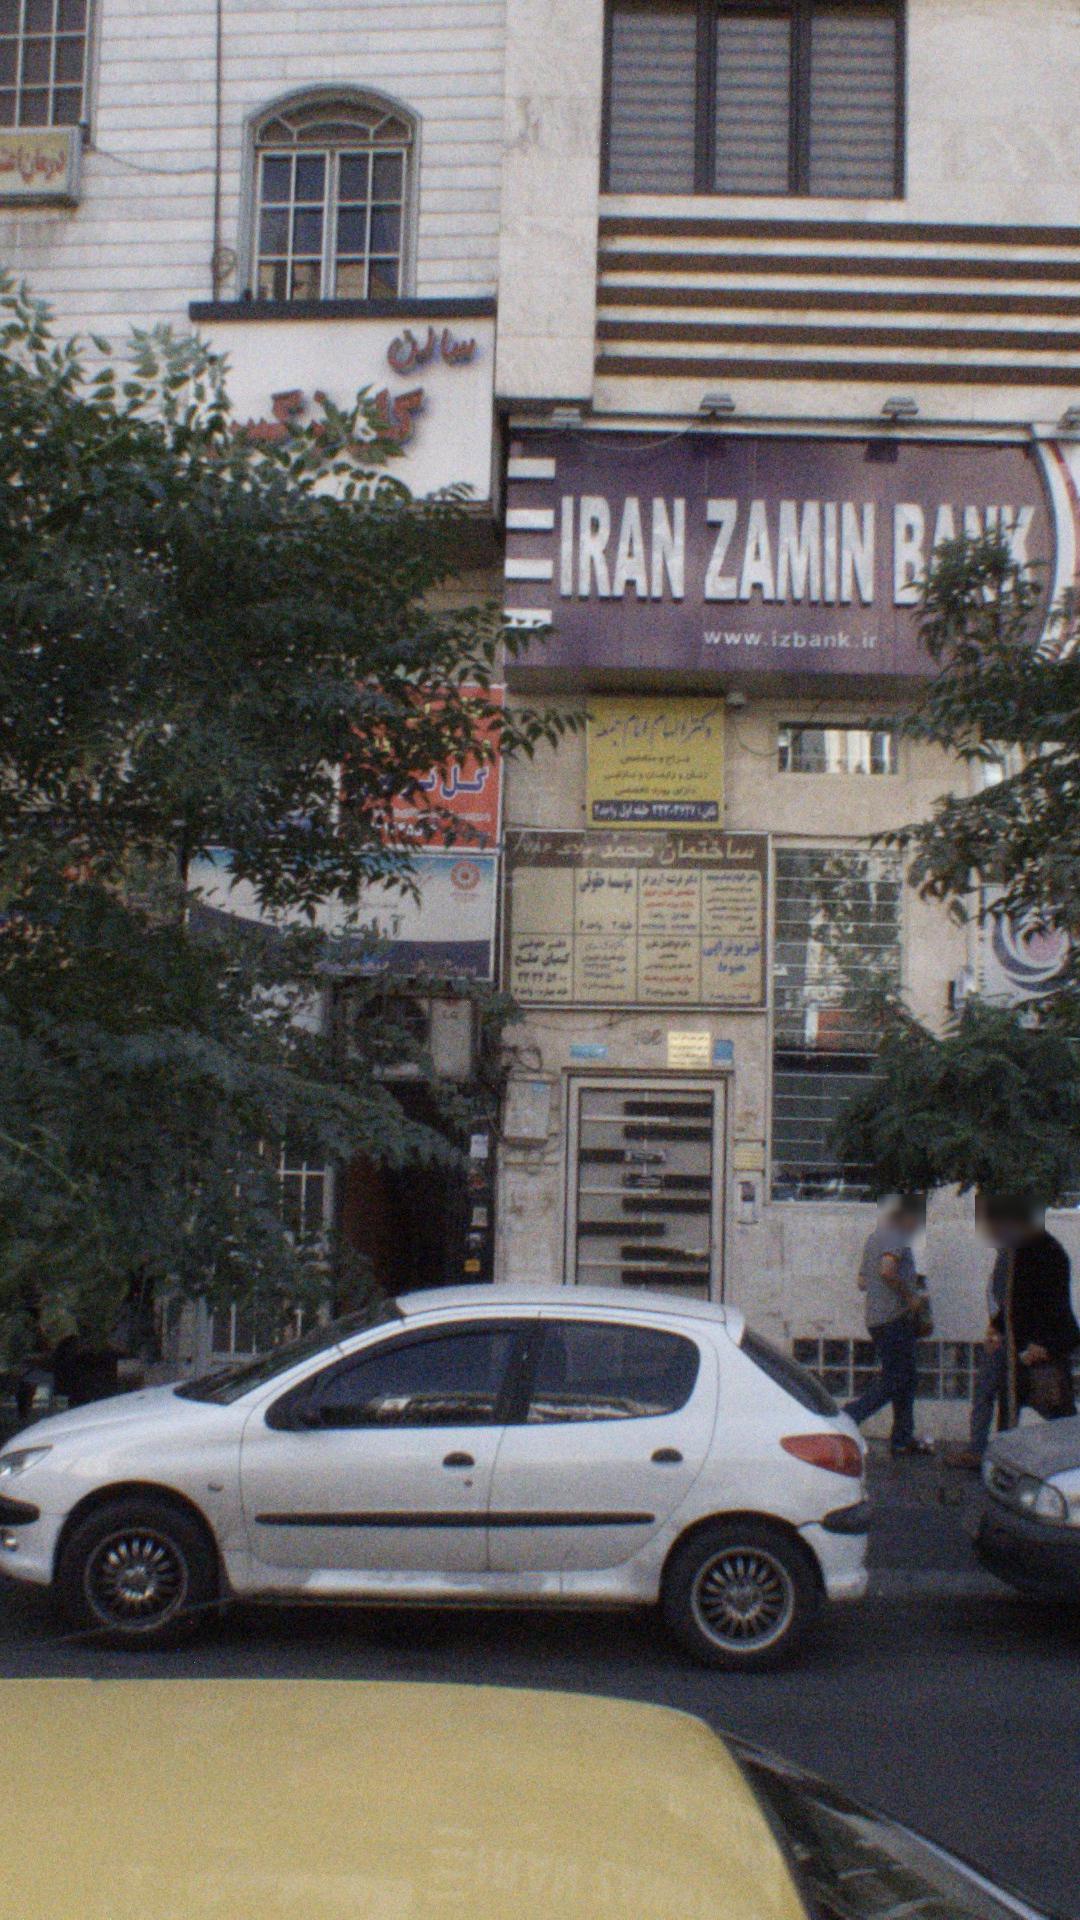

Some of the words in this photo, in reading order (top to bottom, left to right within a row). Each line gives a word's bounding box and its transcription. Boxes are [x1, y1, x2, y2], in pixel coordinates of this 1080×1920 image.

[387, 326, 477, 375] سالن
[559, 495, 687, 599] IRAN
[703, 498, 876, 604] ZAMIN
[703, 627, 878, 650] www.izbank.ir
[659, 837, 755, 865] ساختمان
